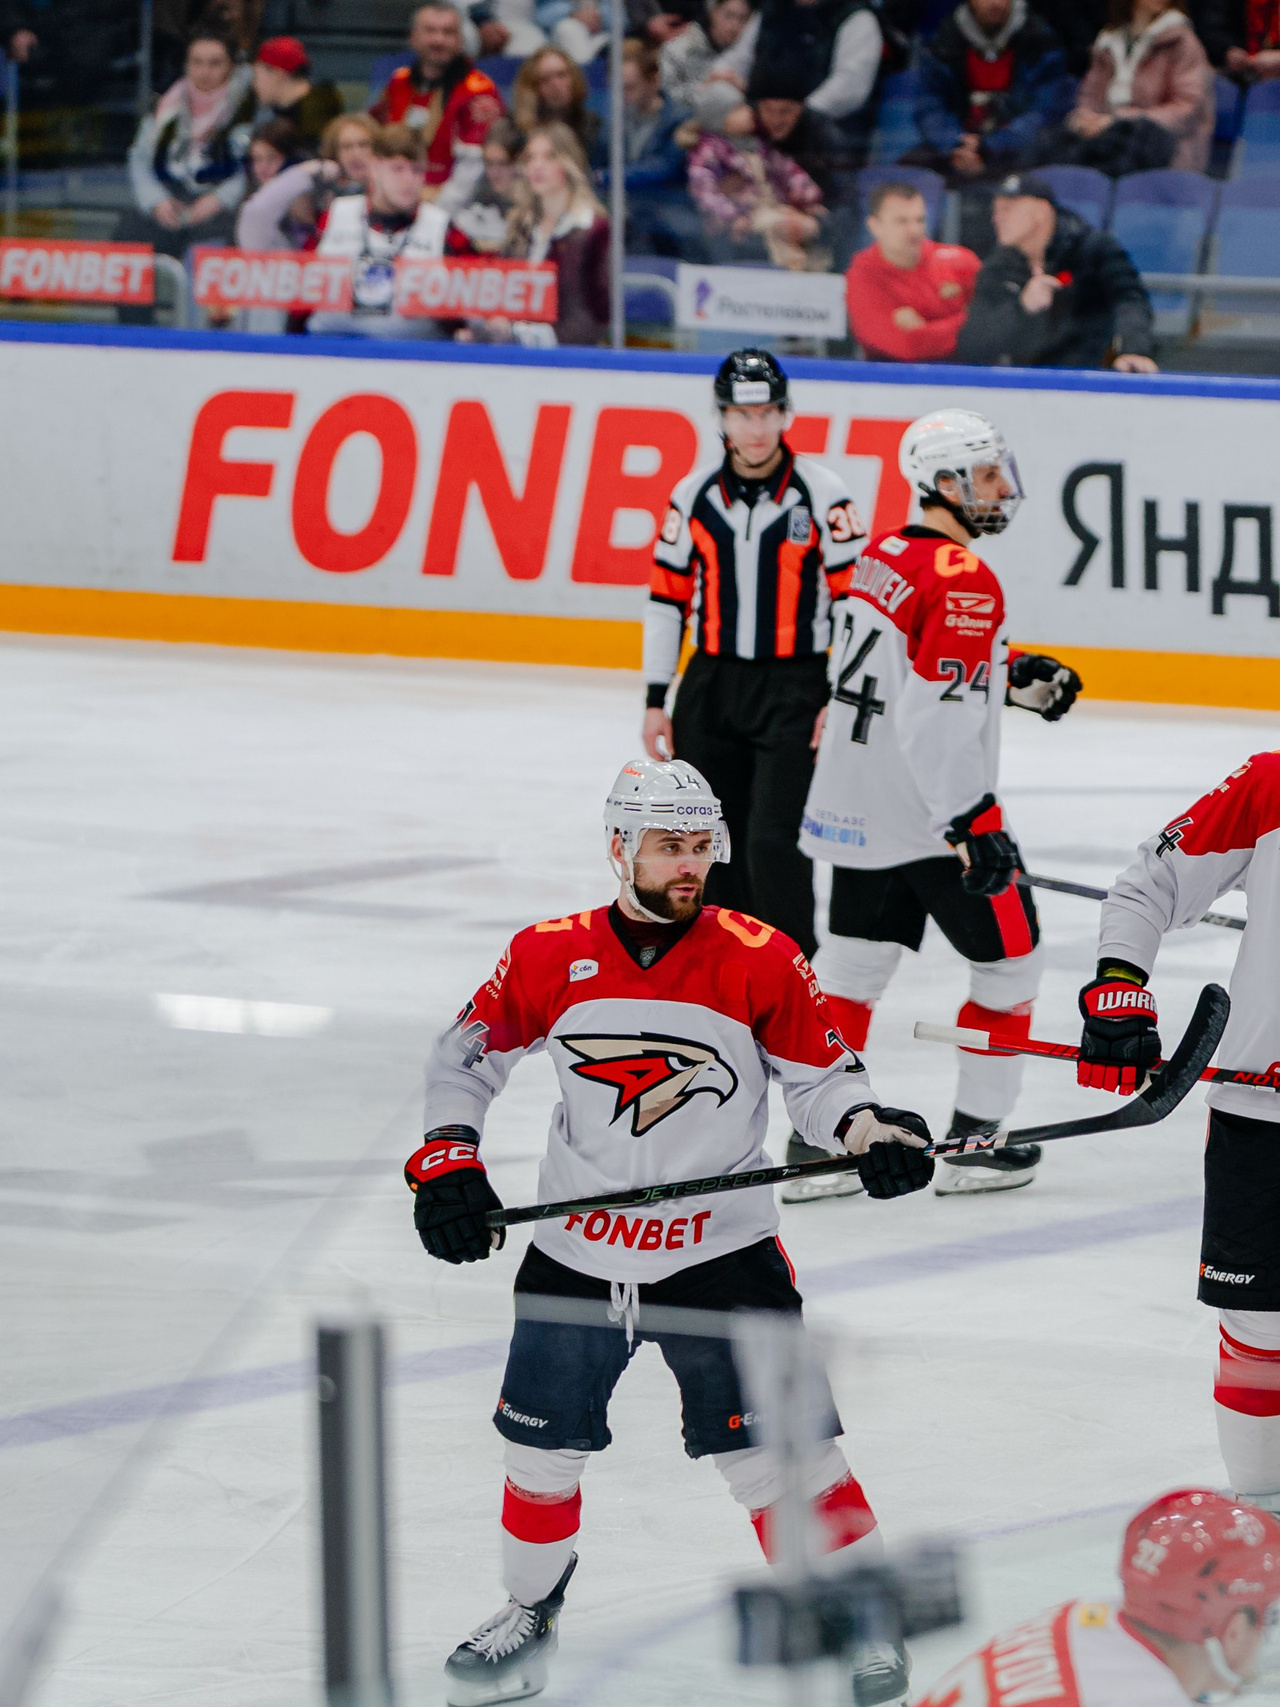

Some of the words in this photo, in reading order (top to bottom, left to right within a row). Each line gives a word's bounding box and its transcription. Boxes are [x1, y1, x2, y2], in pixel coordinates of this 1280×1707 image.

[1, 248, 153, 293] FONBET
[200, 257, 351, 300] FONBET
[403, 269, 554, 312] FONBET
[171, 389, 915, 588] FONBT
[938, 657, 990, 704] 24
[669, 773, 701, 790] 14
[677, 806, 713, 816] согаз
[1155, 816, 1195, 859] 4
[824, 1026, 867, 1073] 1
[420, 1145, 482, 1172] CC
[634, 1171, 768, 1203] JETSPEED
